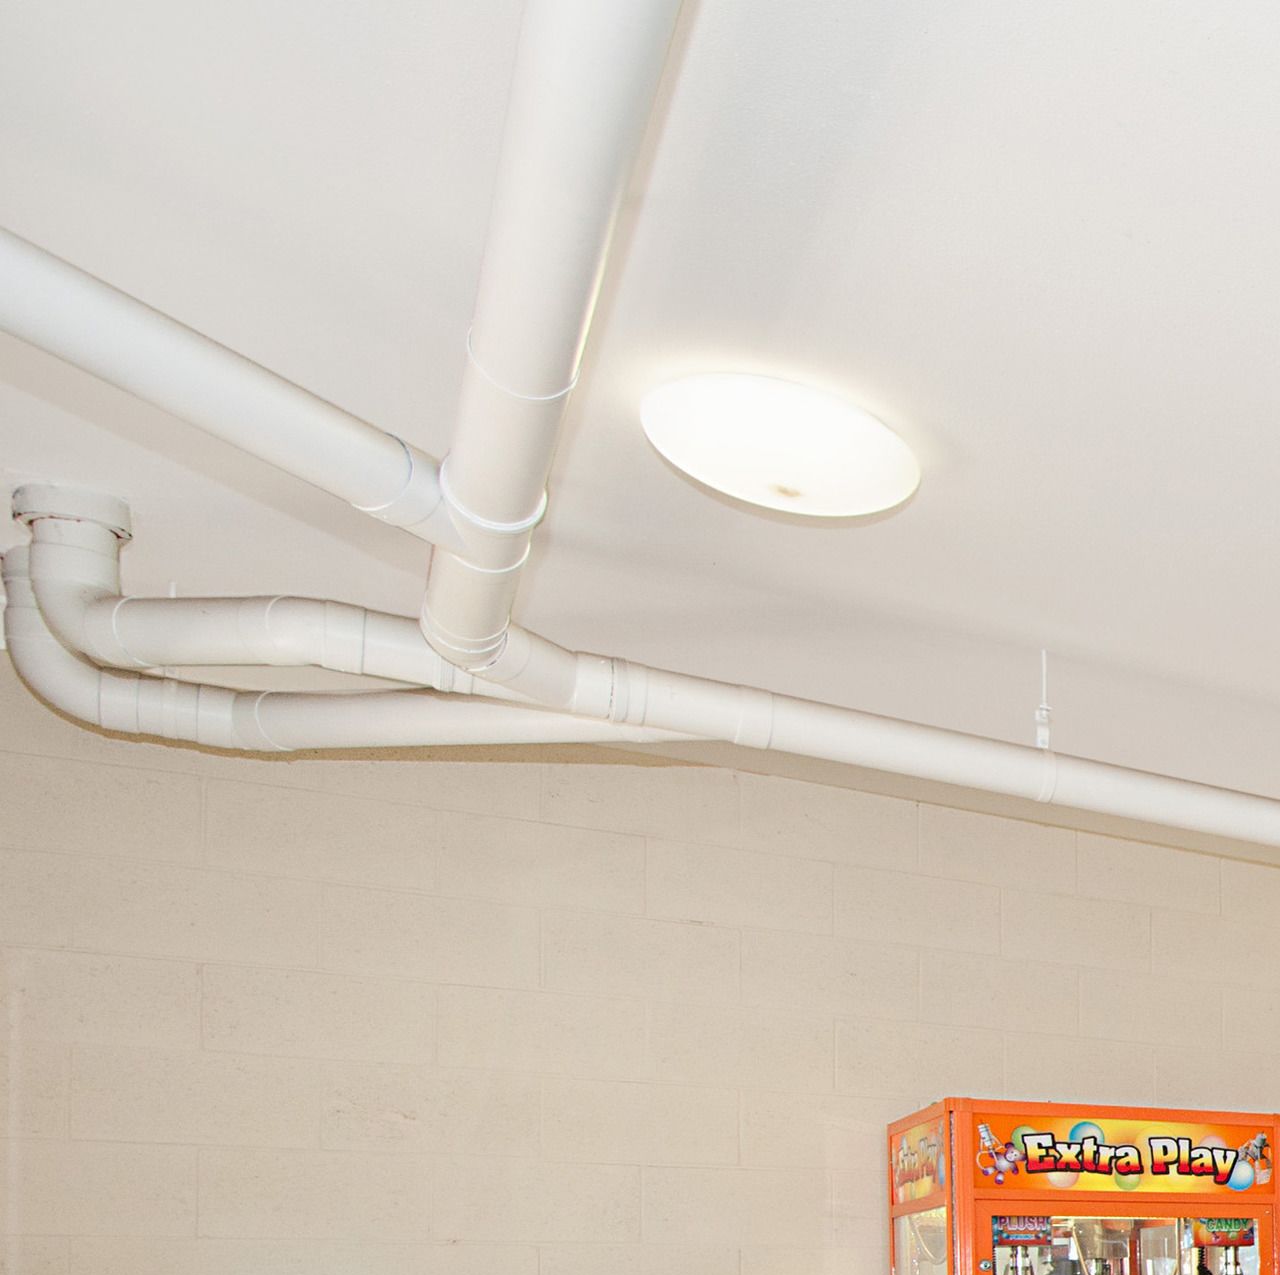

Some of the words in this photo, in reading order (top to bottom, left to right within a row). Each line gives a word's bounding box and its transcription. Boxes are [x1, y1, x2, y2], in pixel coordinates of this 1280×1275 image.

[1022, 1132, 1144, 1176] Extra
[1149, 1137, 1239, 1184] Play
[997, 1216, 1047, 1231] PLUSH
[1206, 1218, 1250, 1232] CANDY
